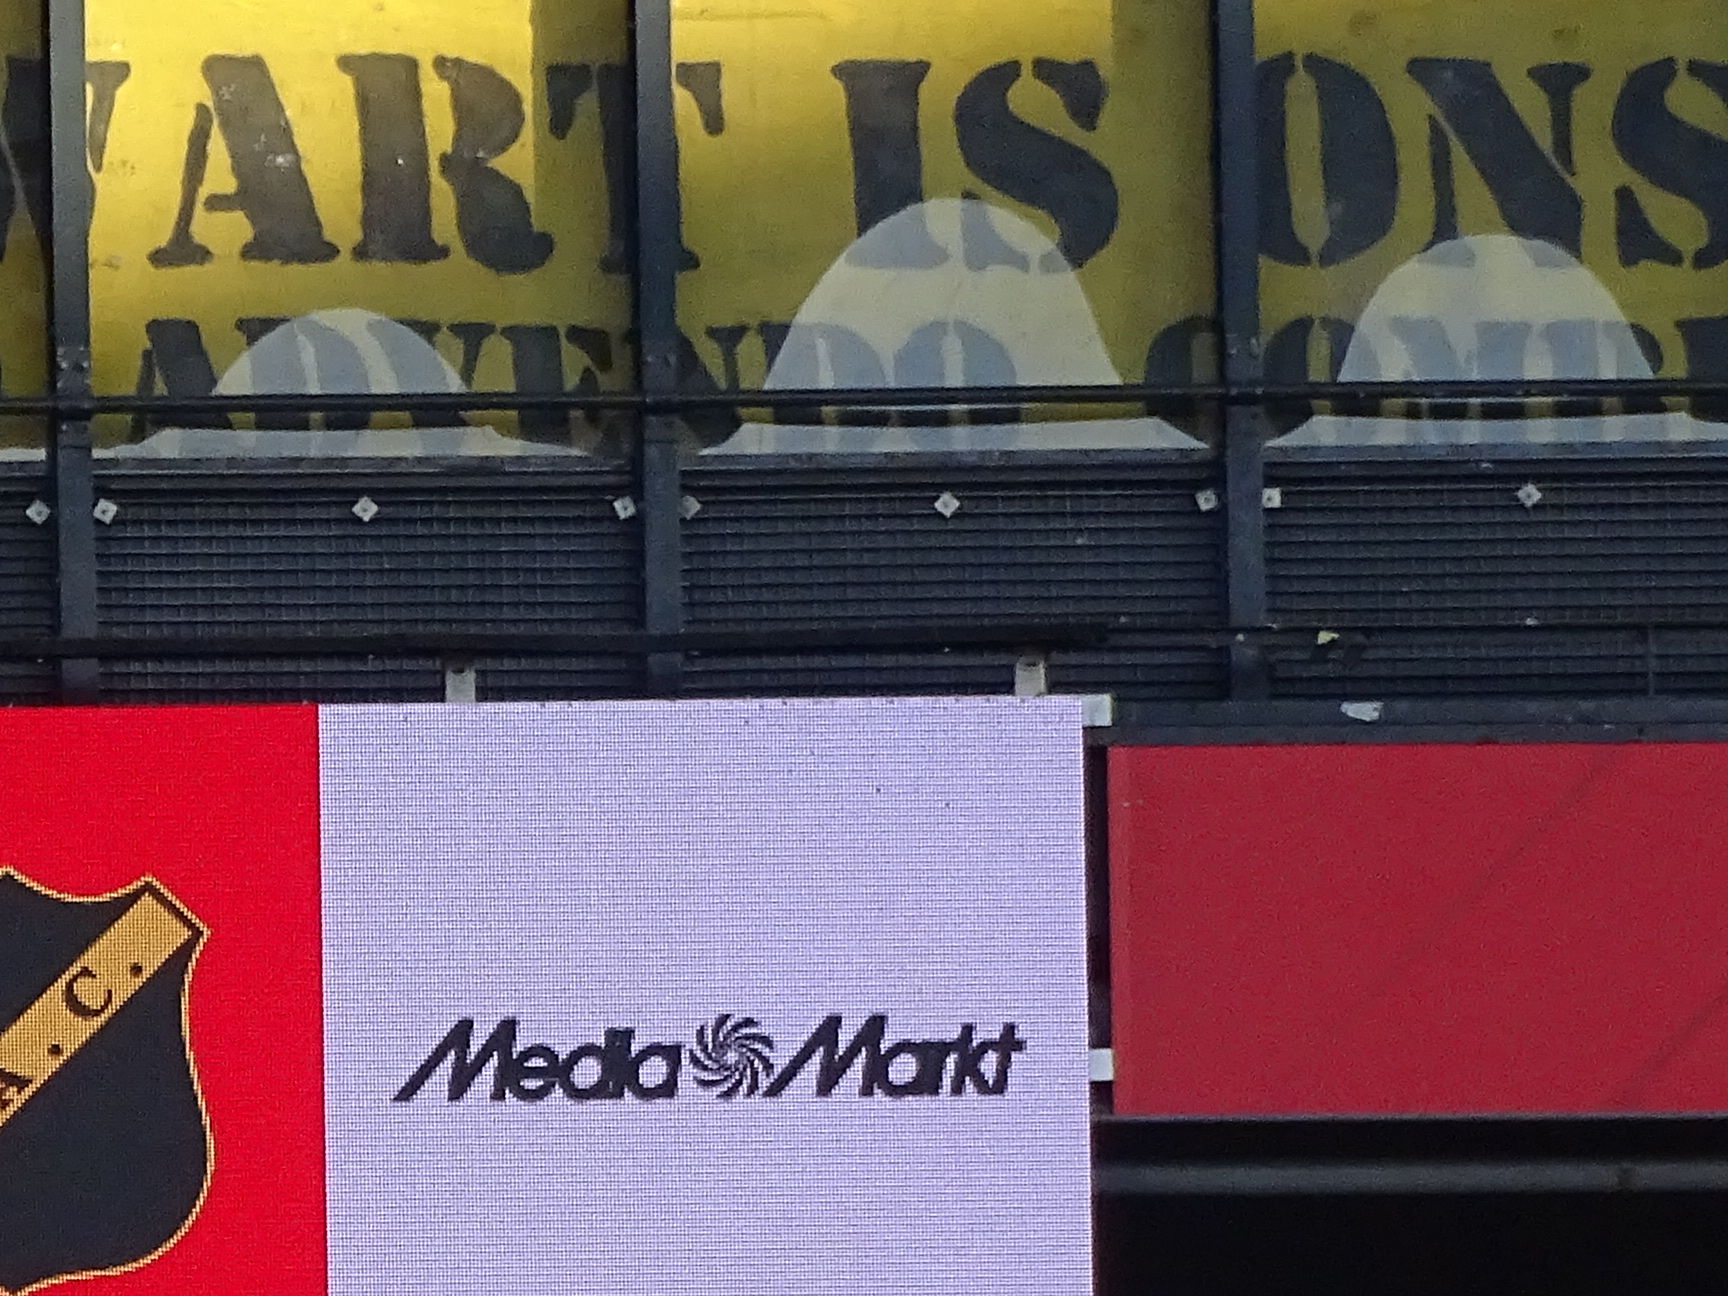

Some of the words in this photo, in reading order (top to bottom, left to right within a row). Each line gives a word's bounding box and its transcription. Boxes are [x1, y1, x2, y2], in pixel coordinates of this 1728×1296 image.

[830, 56, 1121, 272] IS
[1256, 50, 1728, 270] ONS
[390, 1016, 683, 1102] Media
[760, 1013, 1028, 1099] Markt
